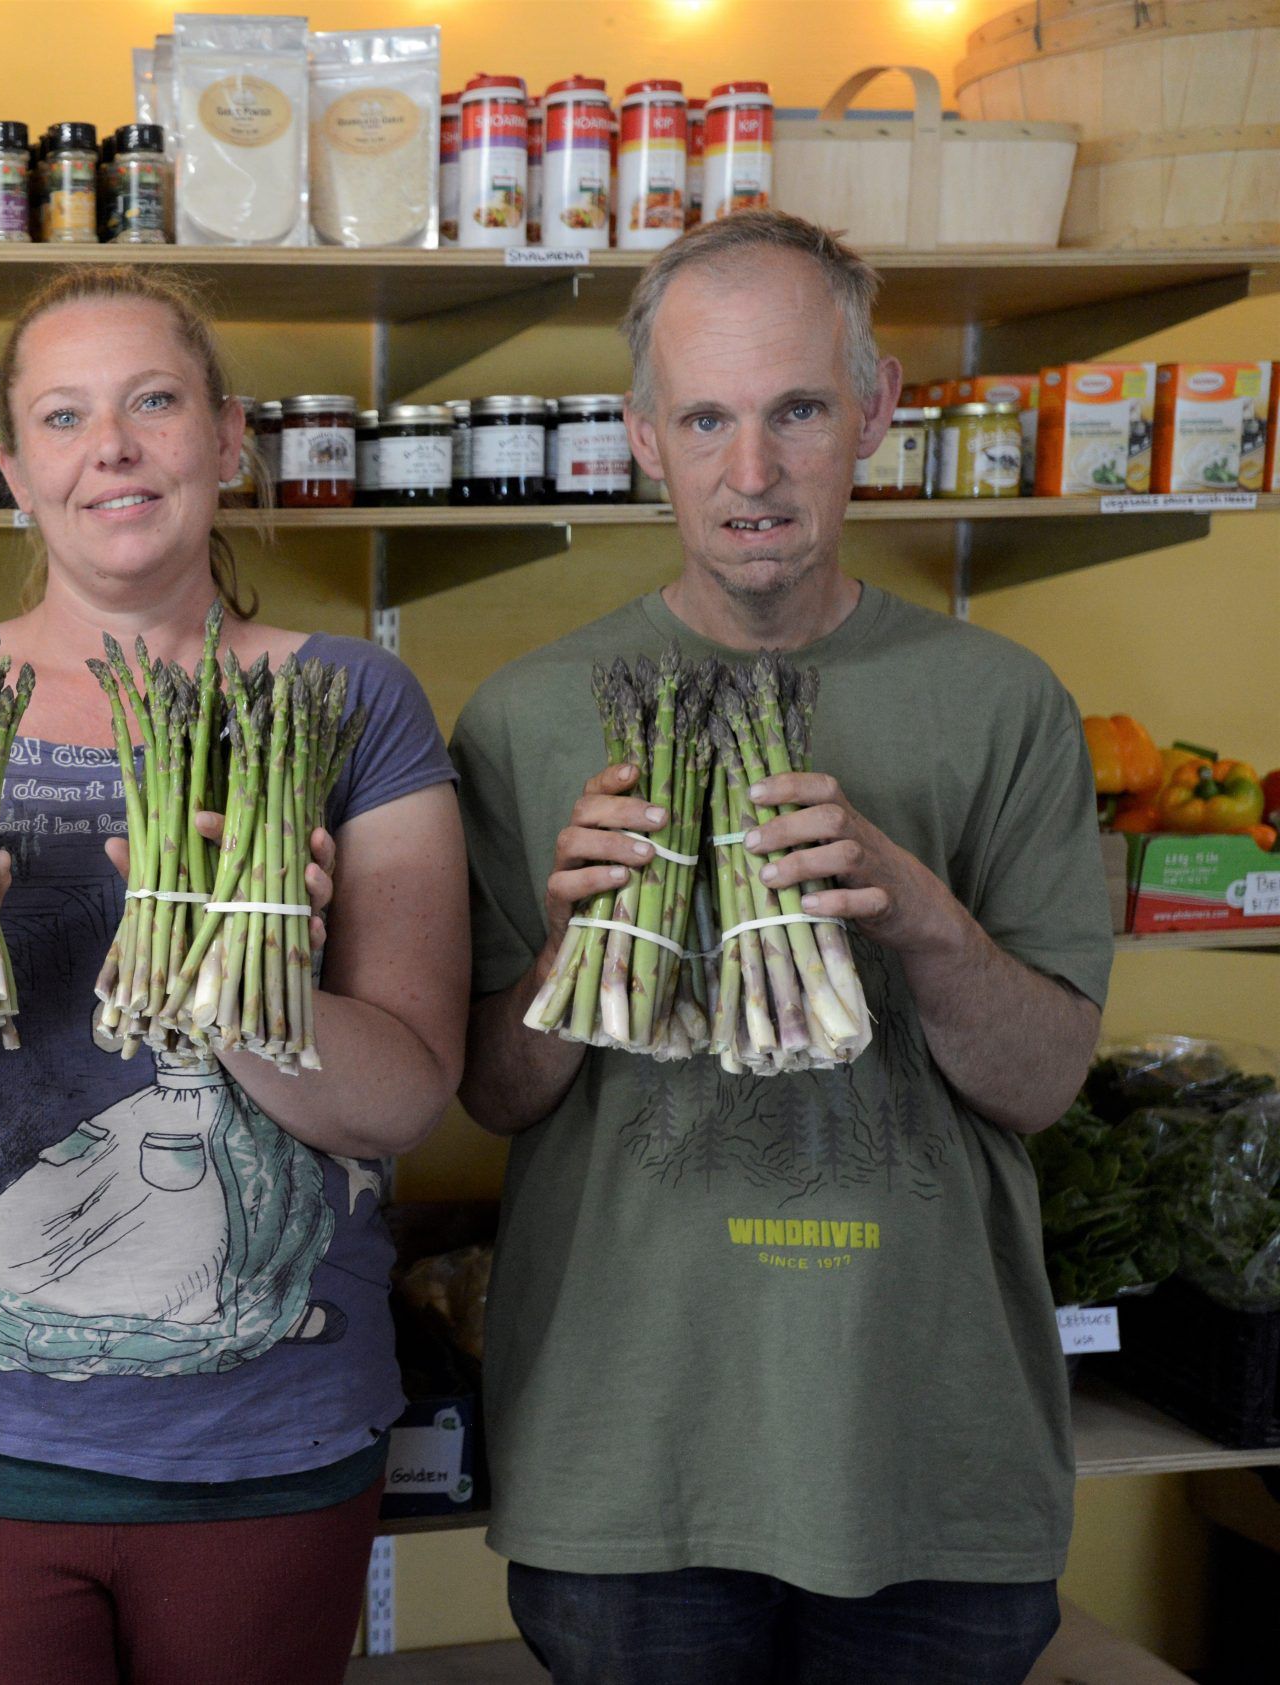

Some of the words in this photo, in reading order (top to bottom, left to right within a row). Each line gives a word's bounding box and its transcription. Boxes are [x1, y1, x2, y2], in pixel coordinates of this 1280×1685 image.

[1256, 875, 1280, 893] BE
[728, 1217, 881, 1249] WINDRIVER
[758, 1251, 809, 1270] SINCE
[817, 1254, 853, 1269] 1977
